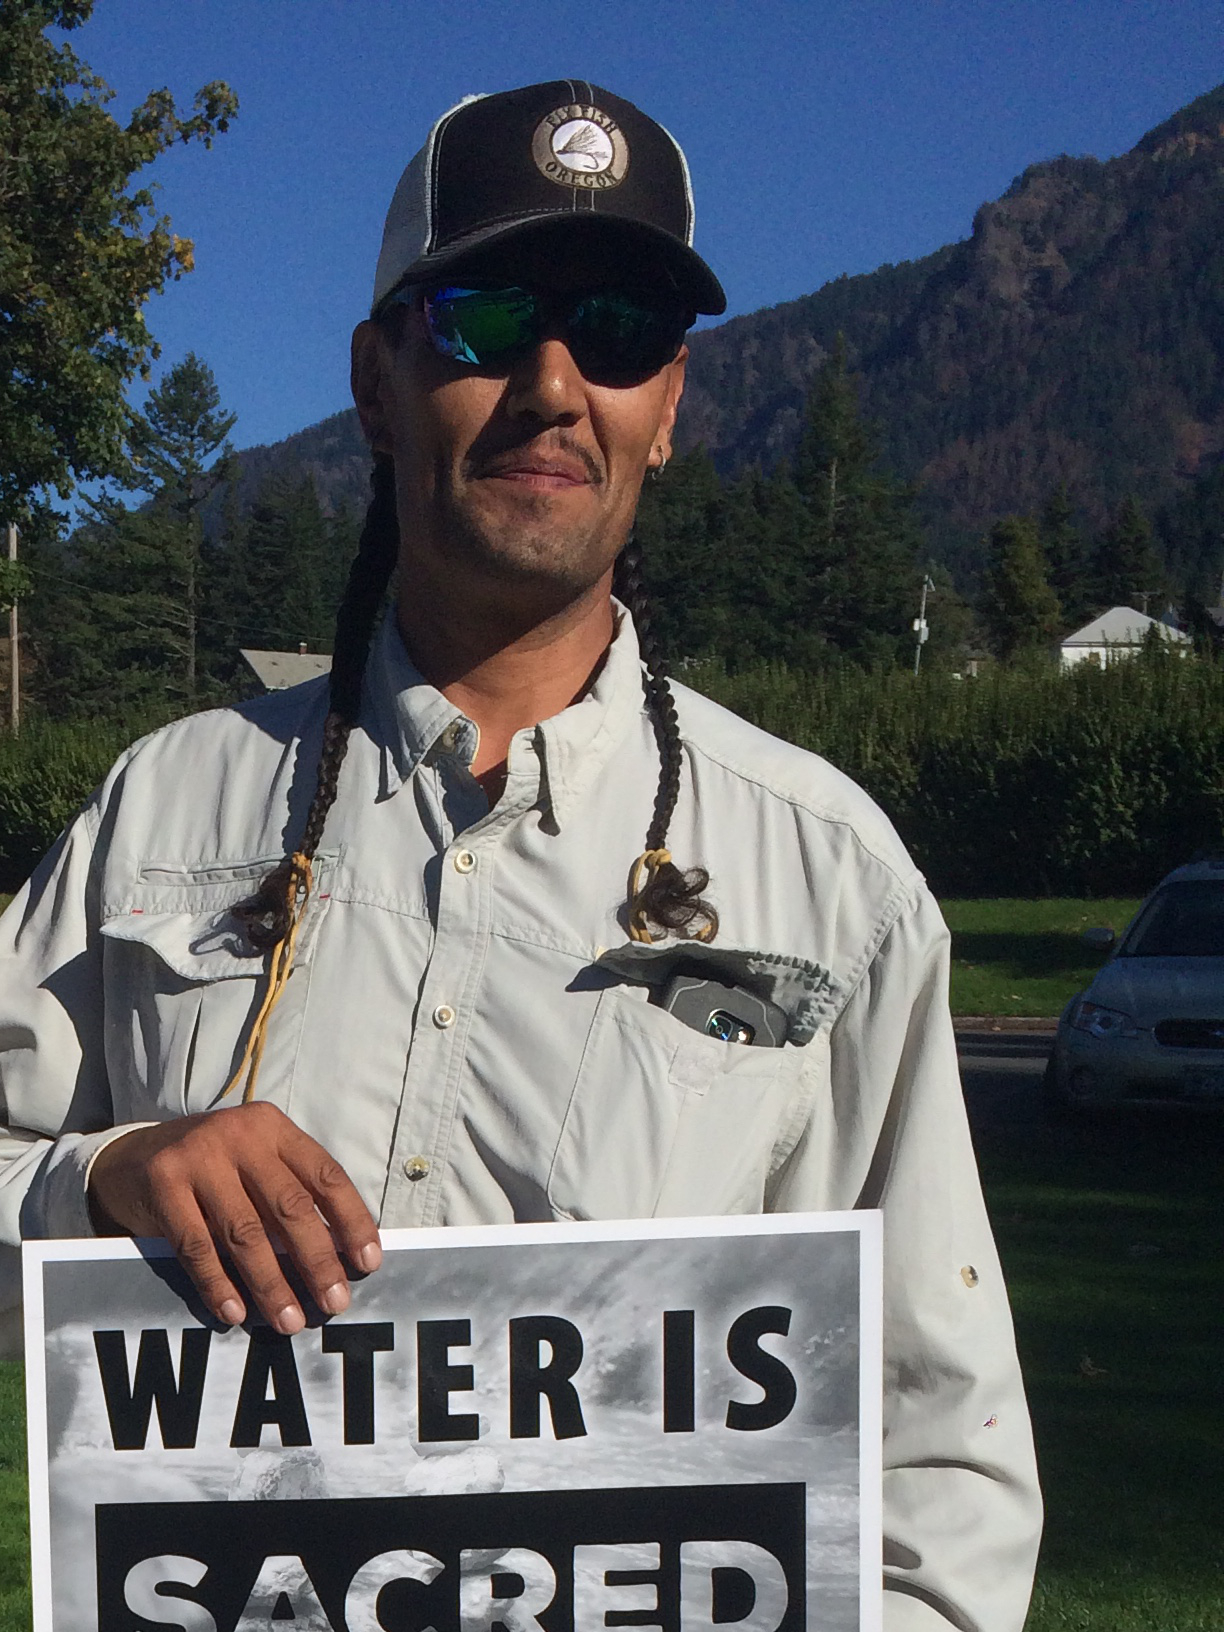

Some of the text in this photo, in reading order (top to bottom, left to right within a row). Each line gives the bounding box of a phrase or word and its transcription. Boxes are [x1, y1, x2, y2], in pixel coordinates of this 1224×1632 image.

[545, 104, 618, 133] FLY FISH
[545, 161, 617, 188] OREGON
[92, 1305, 798, 1450] WATER IS
